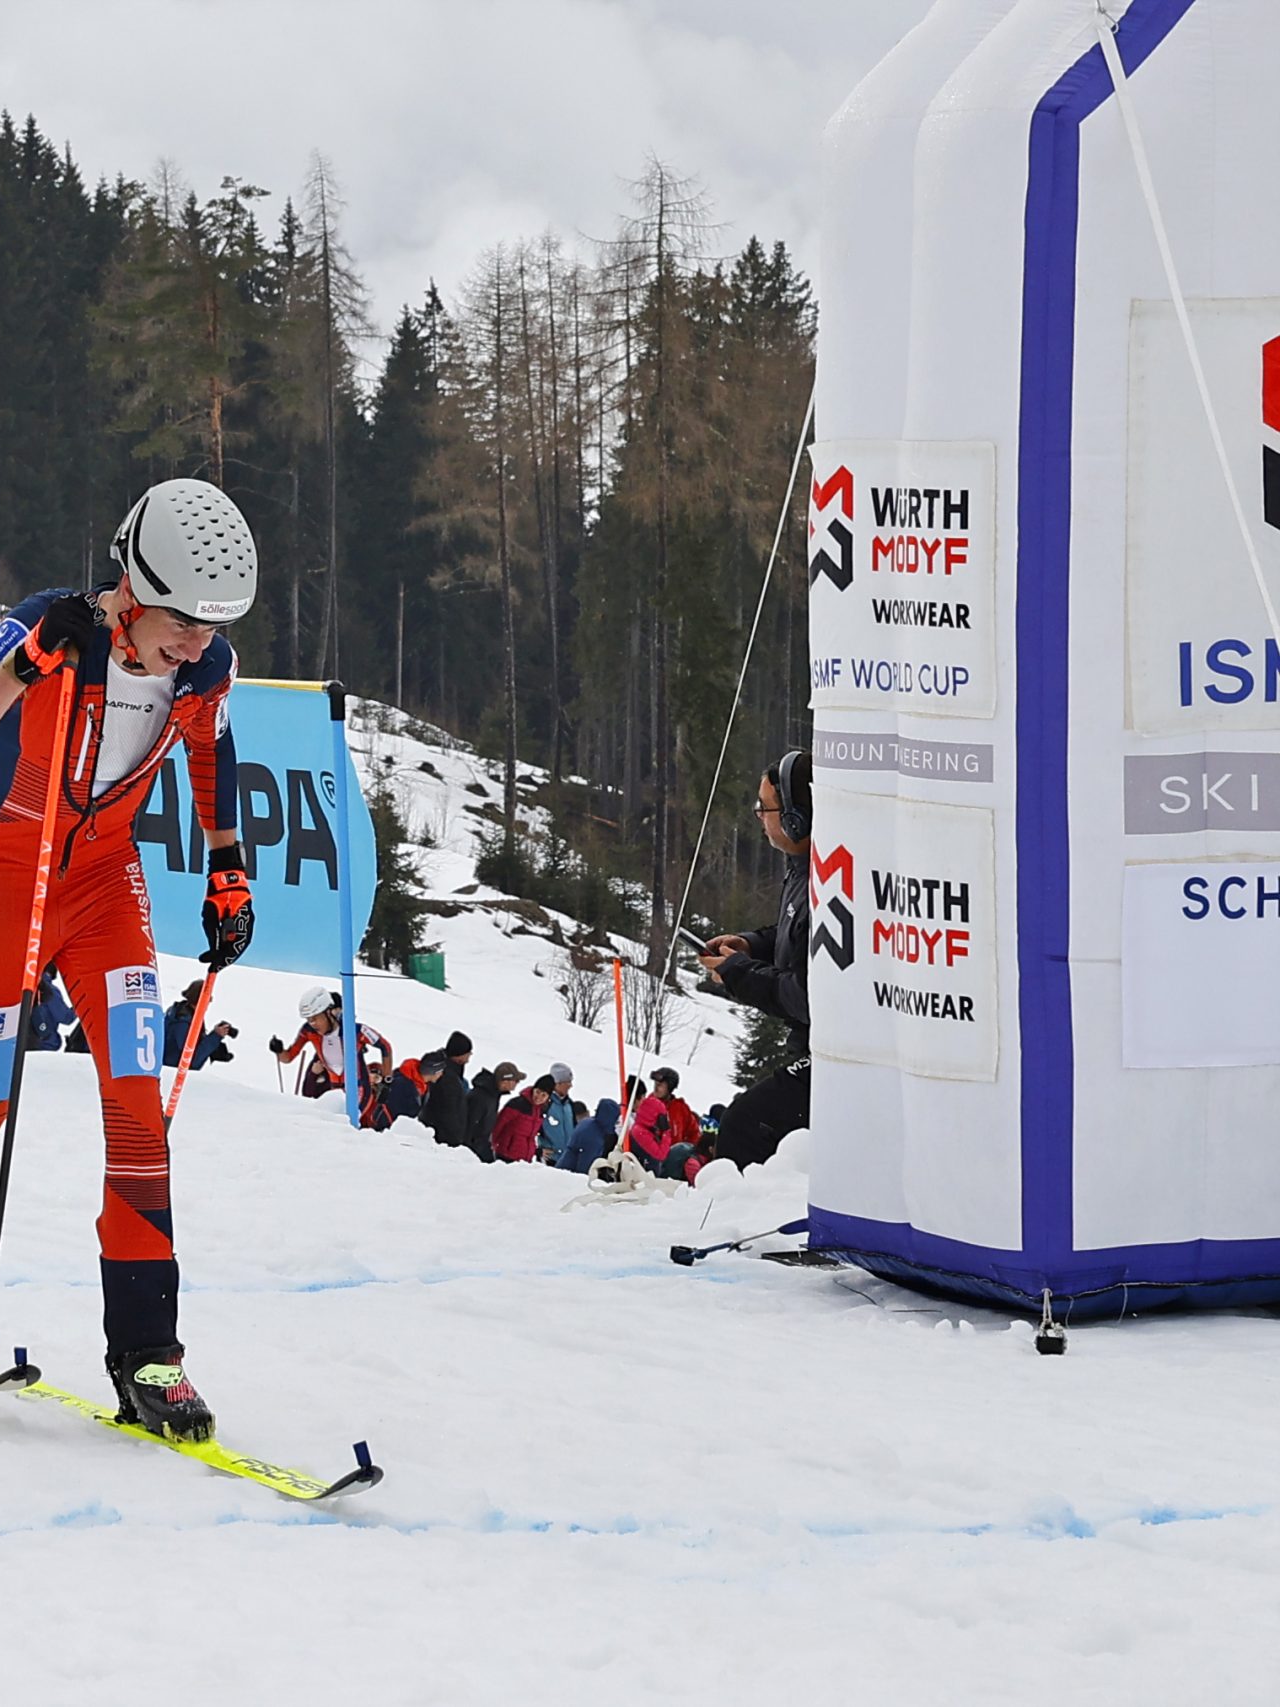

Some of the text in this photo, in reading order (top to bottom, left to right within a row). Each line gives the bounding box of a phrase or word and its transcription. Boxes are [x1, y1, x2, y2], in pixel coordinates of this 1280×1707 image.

[870, 487, 969, 530] WÜRTH
[872, 535, 969, 575] MODYF
[871, 598, 972, 629] WORKWEAR
[812, 657, 970, 697] SMF WORLD CUP
[1159, 773, 1259, 814] SKI
[124, 861, 155, 941] Austria
[870, 869, 970, 923] WÜRTH
[872, 918, 970, 967] MODYF
[873, 980, 976, 1023] WORKWEAR
[136, 1007, 157, 1072] 5
[787, 1057, 811, 1076] MS
